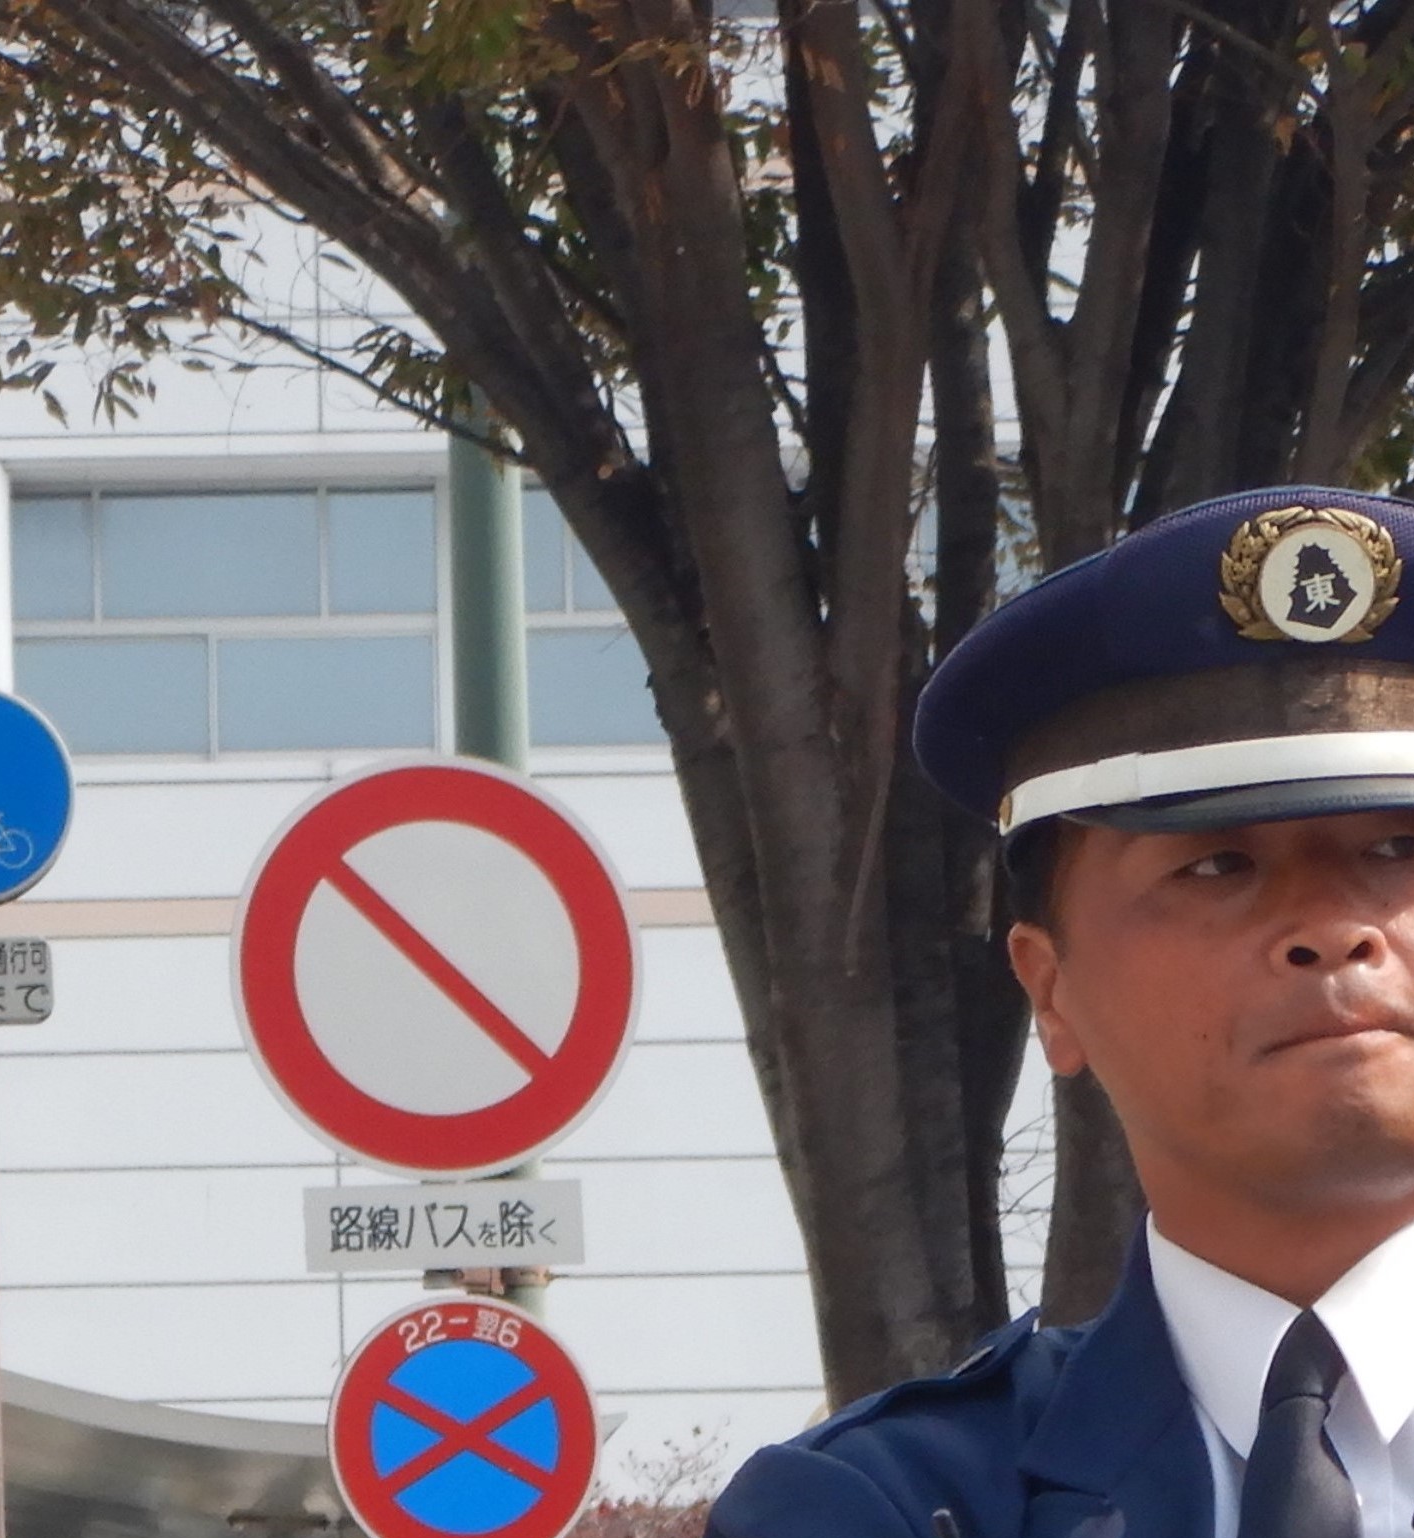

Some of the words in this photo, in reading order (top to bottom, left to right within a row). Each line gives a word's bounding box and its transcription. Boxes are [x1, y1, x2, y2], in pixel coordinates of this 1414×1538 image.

[1301, 573, 1340, 613] 東
[330, 1201, 558, 1254] 路線バスを除く
